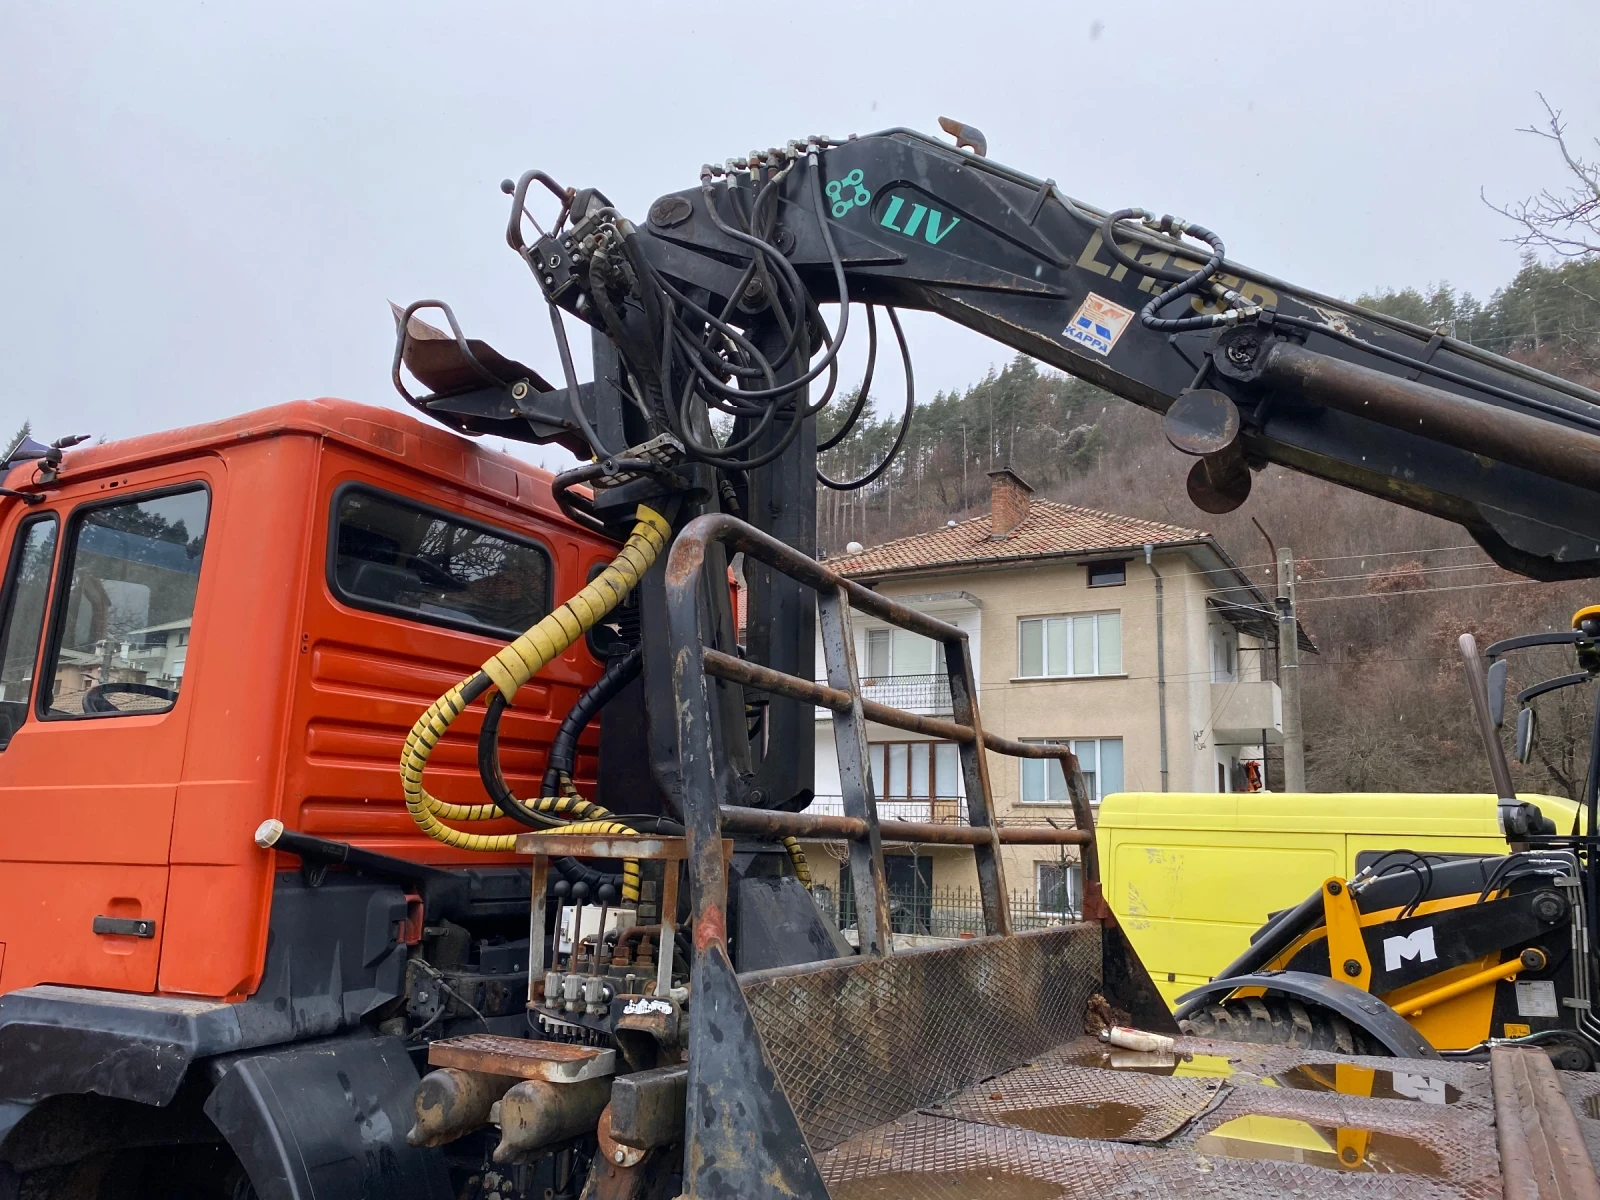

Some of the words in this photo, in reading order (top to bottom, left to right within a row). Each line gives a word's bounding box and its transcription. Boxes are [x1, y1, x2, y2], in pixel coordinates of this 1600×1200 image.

[880, 195, 961, 245] LIV
[1065, 326, 1108, 353] KAPPA
[1383, 926, 1438, 972] M
